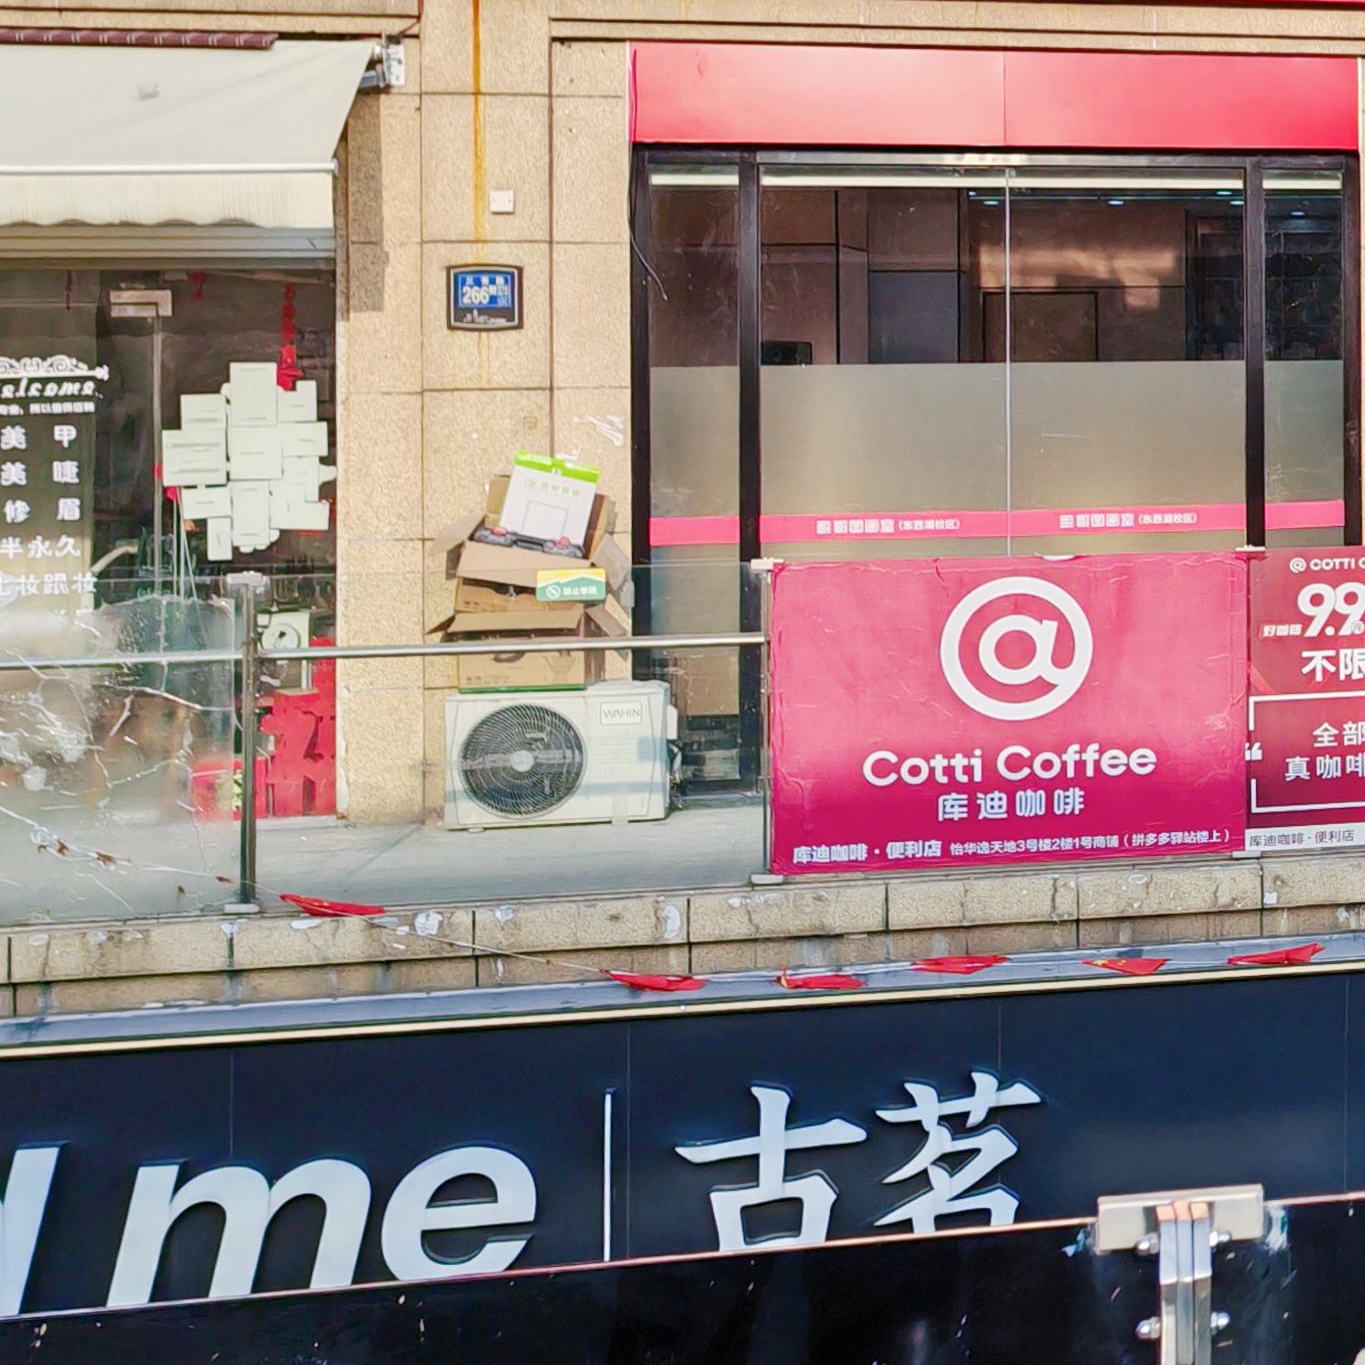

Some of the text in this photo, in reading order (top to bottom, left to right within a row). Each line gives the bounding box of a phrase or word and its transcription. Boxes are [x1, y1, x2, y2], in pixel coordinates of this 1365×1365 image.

[1309, 557, 1356, 572] COTTI
[862, 741, 1157, 787] Cotti Coffee
[937, 787, 1085, 823] 库迪咖啡
[674, 1069, 1042, 1253] 古茗
